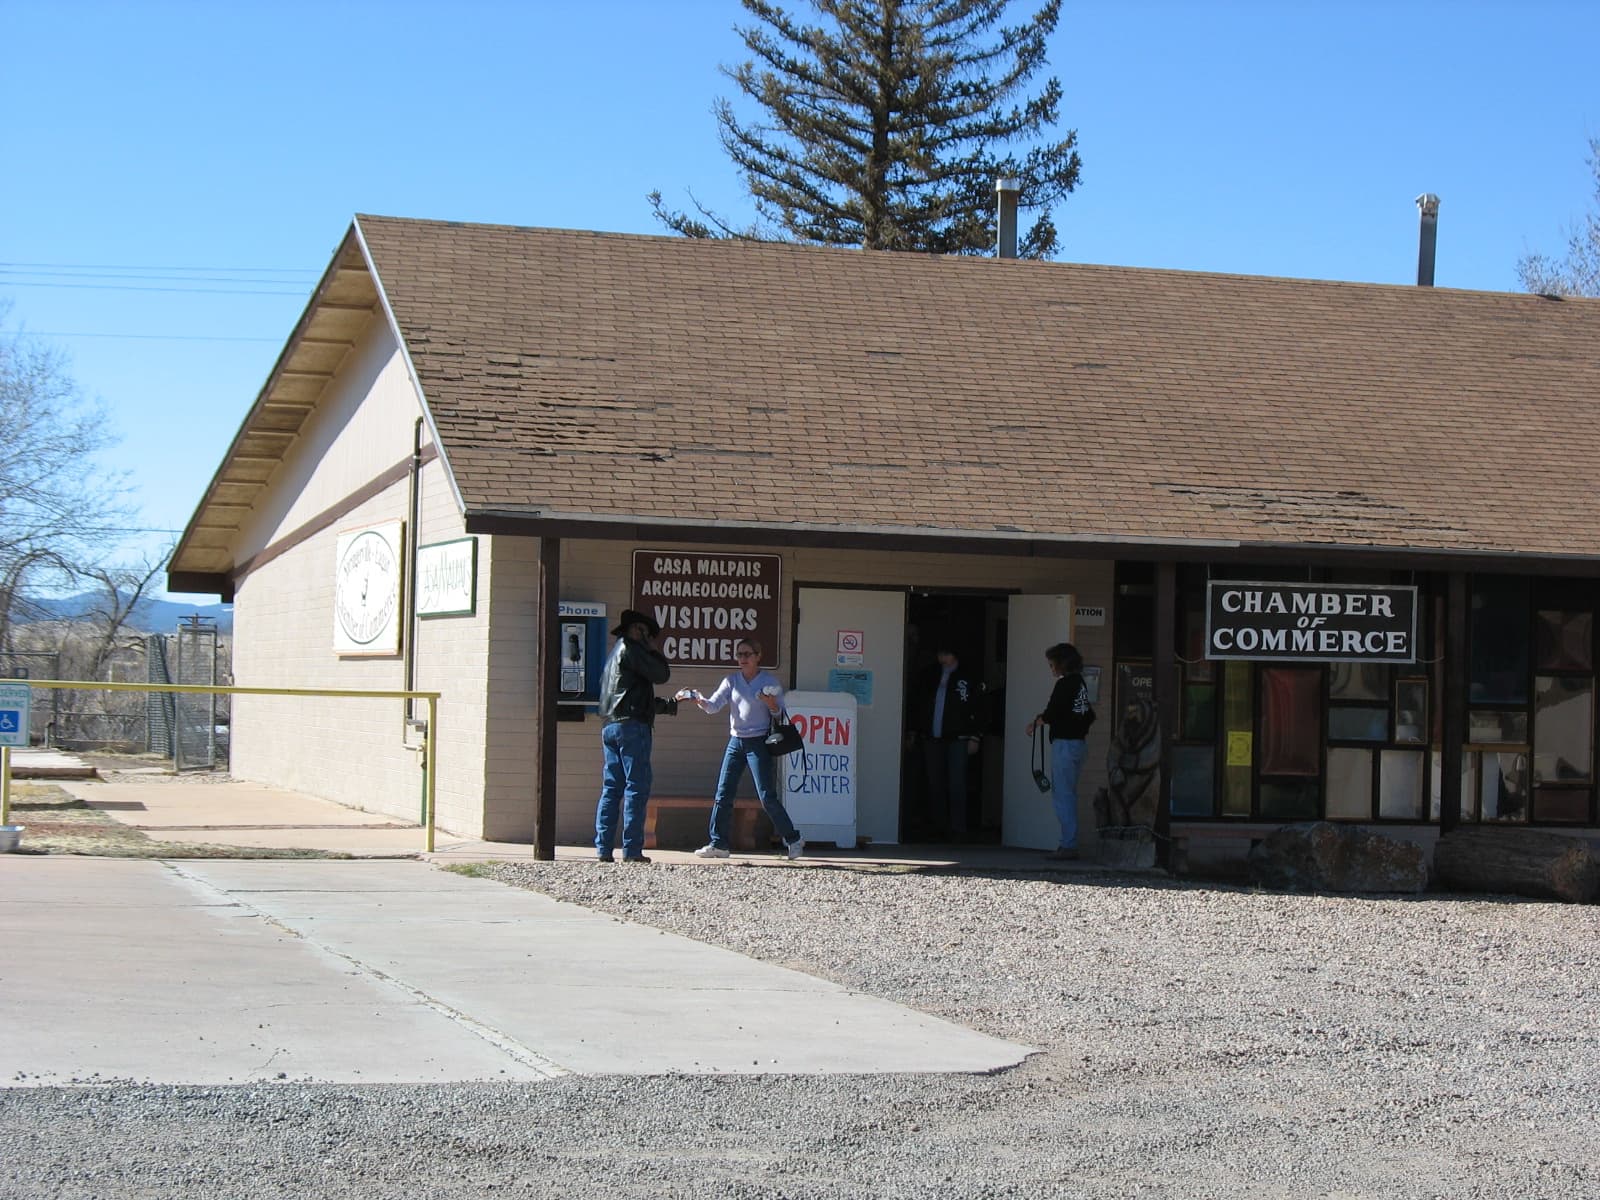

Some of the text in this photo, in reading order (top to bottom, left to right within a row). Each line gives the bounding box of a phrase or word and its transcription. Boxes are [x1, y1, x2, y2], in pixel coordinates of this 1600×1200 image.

[653, 557, 761, 577] CASA MALPAIS
[641, 580, 772, 600] ARCHAEOLOGICAL
[559, 605, 599, 615] Phone
[1075, 607, 1103, 617] ATION
[1221, 590, 1395, 618] CHAMBER
[654, 604, 758, 631] VISITORS
[1296, 616, 1328, 628] OF
[1213, 627, 1407, 653] COMMERCE
[1131, 676, 1152, 688] OPE
[789, 714, 850, 746] OPEN
[789, 752, 849, 772] VISITOR
[787, 774, 850, 794] CENTER
